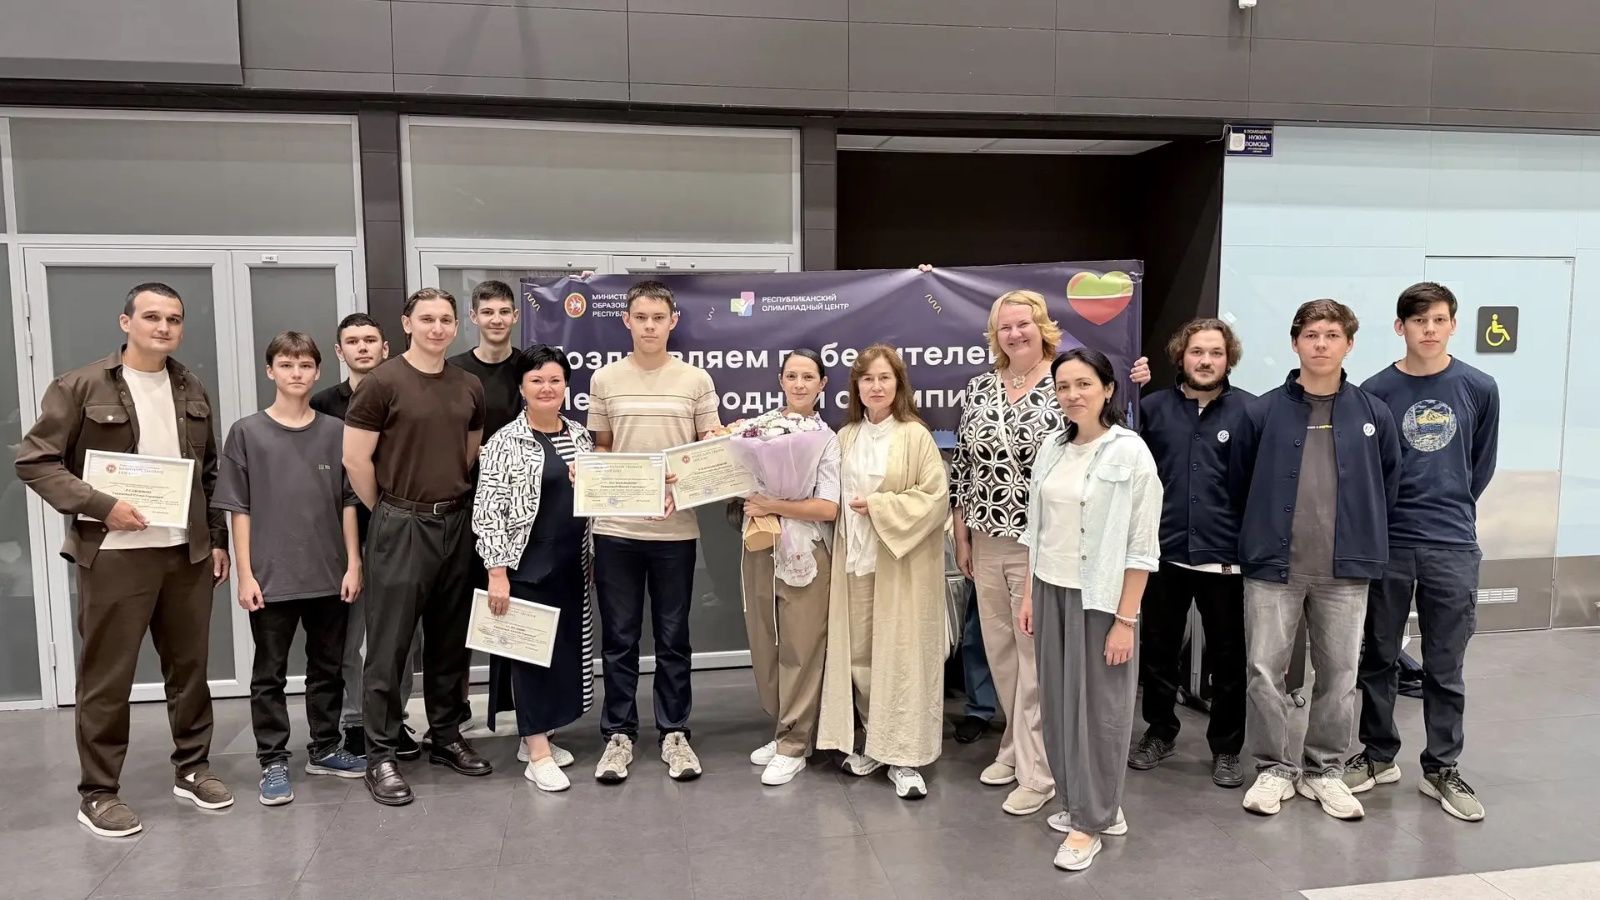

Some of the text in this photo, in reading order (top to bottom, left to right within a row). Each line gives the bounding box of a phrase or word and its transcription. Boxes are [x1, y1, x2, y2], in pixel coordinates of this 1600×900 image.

[762, 294, 837, 303] РЕСПУБЛИКАНСКИЙ
[762, 303, 850, 312] ОЛИМПИАДНЫЙ ЦЕНТР
[556, 346, 769, 370] оздляем
